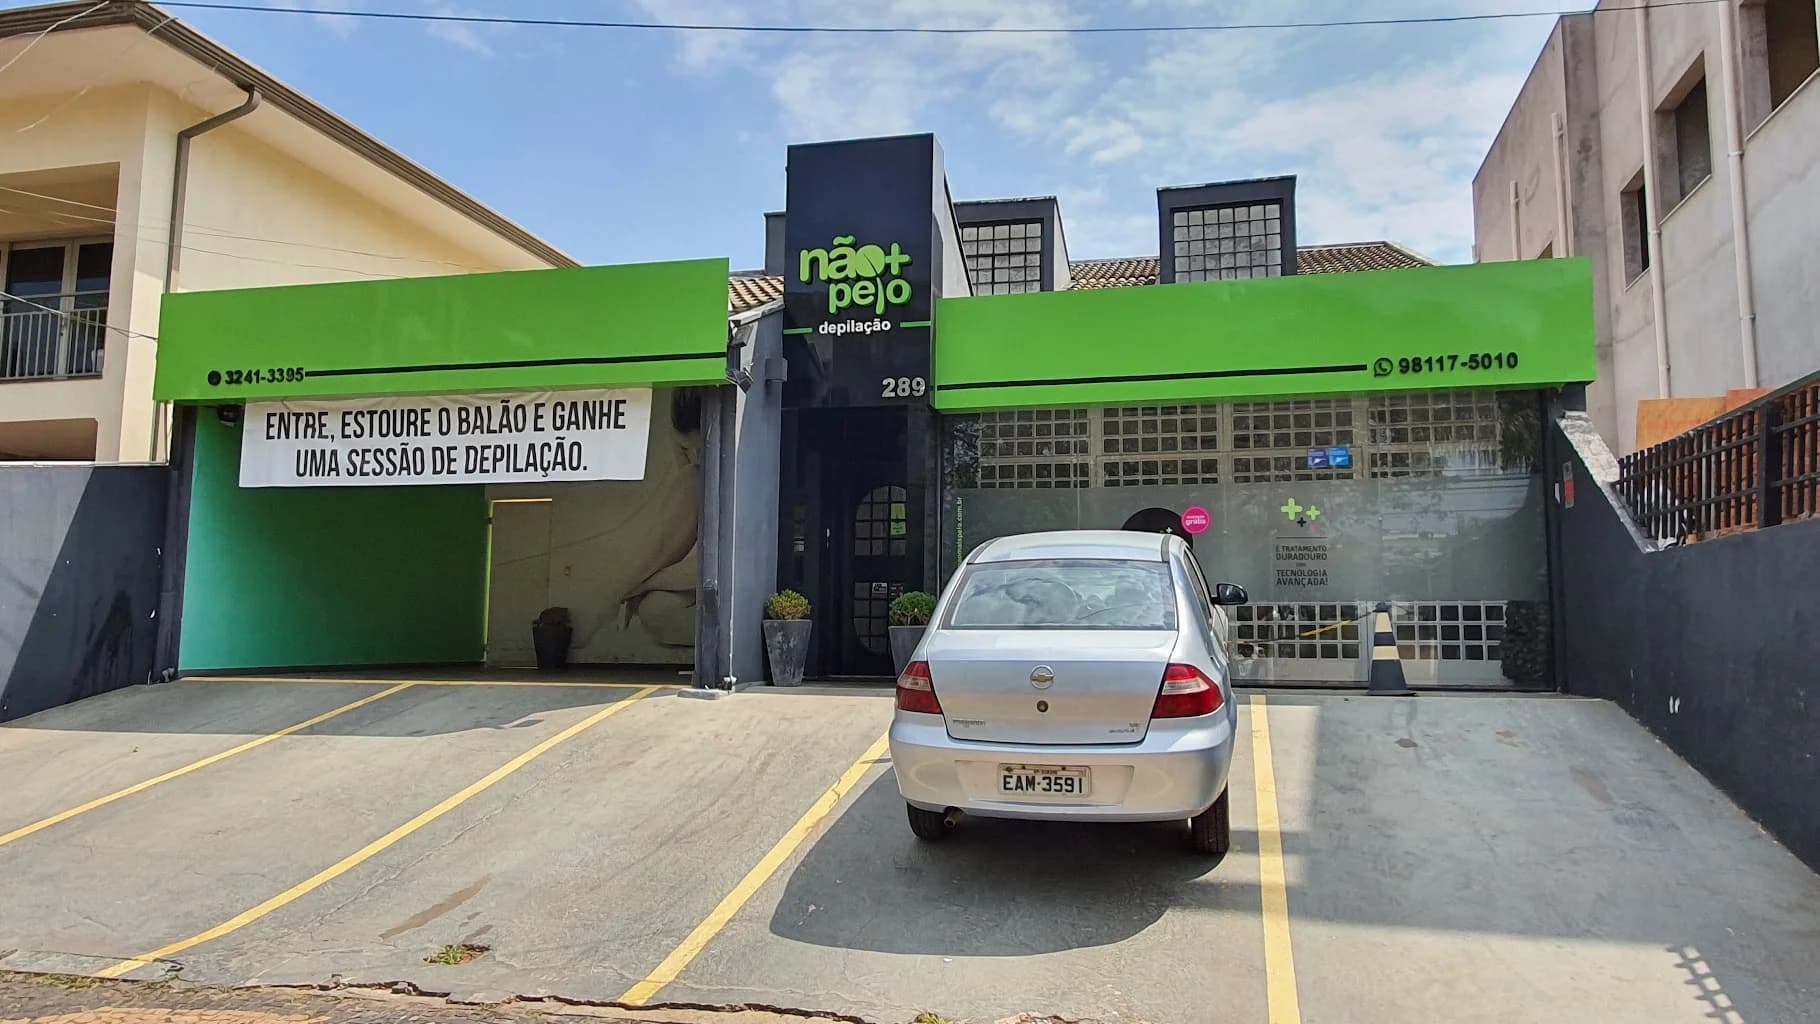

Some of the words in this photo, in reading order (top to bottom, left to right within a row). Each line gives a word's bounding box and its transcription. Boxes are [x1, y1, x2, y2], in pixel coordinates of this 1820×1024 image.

[818, 318, 892, 337] depilação
[1398, 352, 1519, 374] 98117-5010
[225, 367, 304, 385] 3241-3395
[881, 376, 926, 398] 289
[265, 411, 335, 443] ENTRE,
[340, 408, 431, 439] ESTOURE
[438, 407, 451, 436] O
[457, 400, 527, 436] BALÃO
[533, 403, 546, 432] E
[552, 399, 627, 431] GANHE
[295, 449, 340, 477] UMA
[346, 442, 425, 477] SESSÃO
[432, 446, 458, 475] DE
[464, 436, 588, 478] DEPILAÇÃO.
[1275, 552, 1328, 561] DURADOURO
[1281, 544, 1327, 552] TRATAMENTO
[1276, 569, 1328, 577] TECNOLOGIA
[1276, 577, 1328, 588] AVANÇADA!
